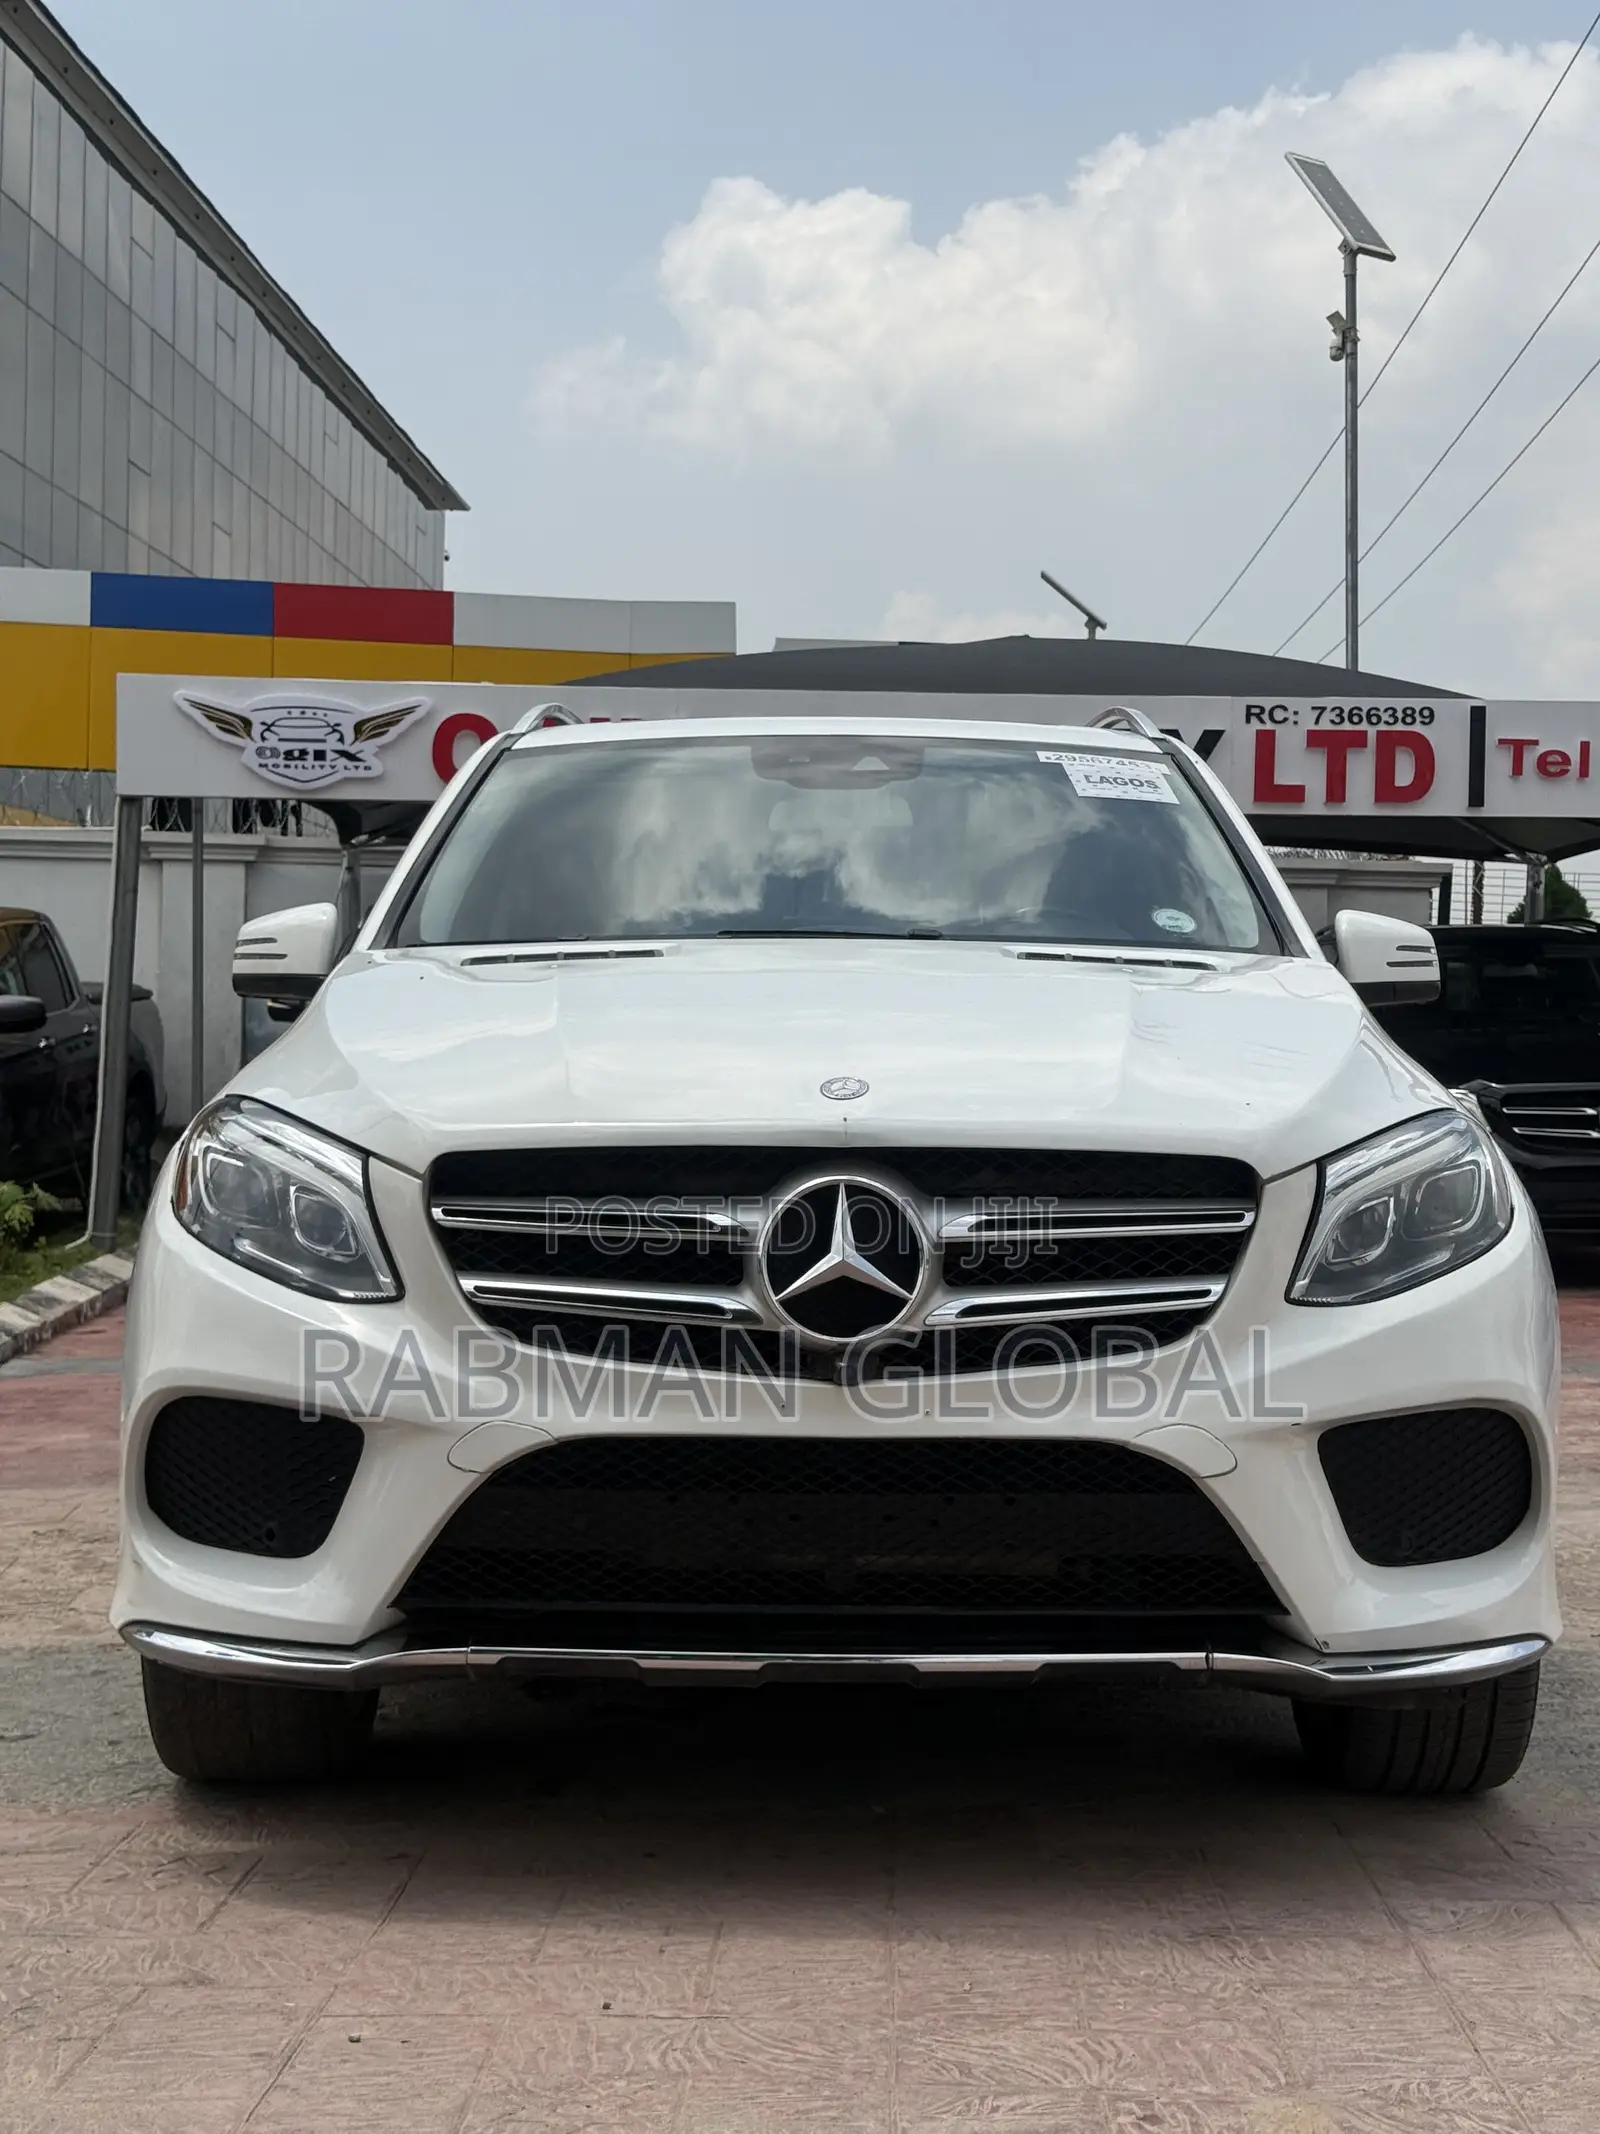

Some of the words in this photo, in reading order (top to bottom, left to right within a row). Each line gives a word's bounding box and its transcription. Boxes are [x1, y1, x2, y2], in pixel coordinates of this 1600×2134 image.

[1245, 704, 1299, 725] RC:
[1311, 706, 1436, 726] 7366389
[1253, 729, 1436, 804] LTD
[1496, 738, 1591, 779] Tel
[1083, 774, 1162, 790] LAGOS
